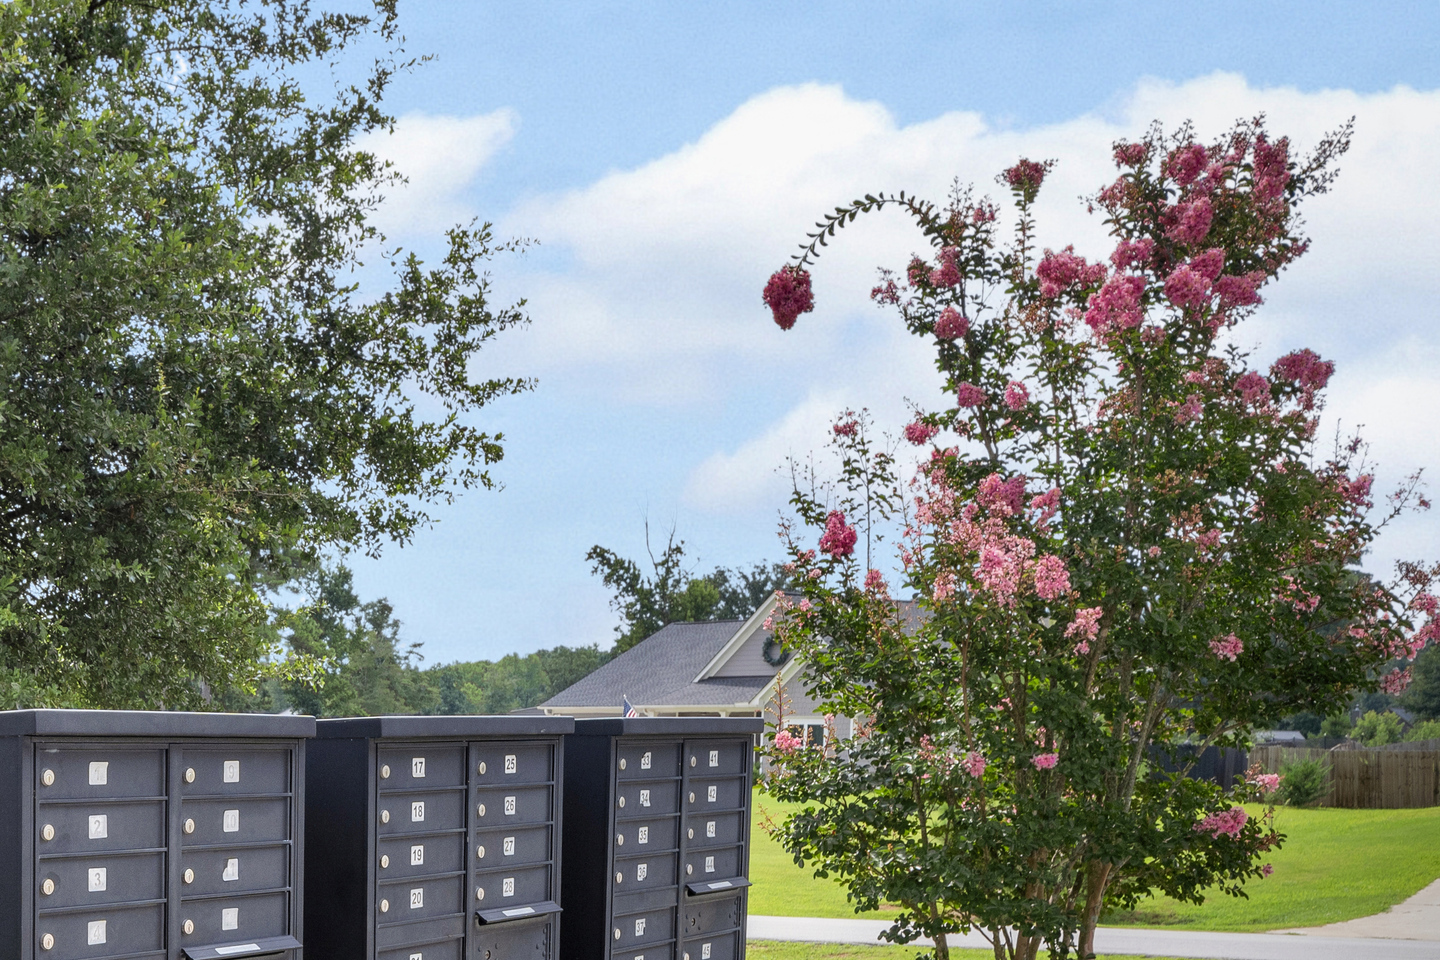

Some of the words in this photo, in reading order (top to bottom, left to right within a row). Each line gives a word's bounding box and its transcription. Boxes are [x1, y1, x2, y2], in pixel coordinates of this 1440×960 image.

[506, 758, 516, 770] 25
[710, 753, 718, 764] 41
[228, 764, 235, 780] 9
[413, 762, 424, 774] 17
[641, 792, 649, 804] 34
[709, 788, 716, 799] 42
[412, 805, 424, 818] 18
[505, 799, 515, 812] 26
[93, 819, 101, 836] 2
[226, 814, 237, 830] 10
[640, 829, 648, 841] 35
[504, 840, 514, 852] 27
[412, 849, 422, 862] 19
[94, 872, 102, 888] 3
[504, 881, 514, 893] 28
[411, 892, 422, 904] 20
[93, 924, 101, 940] 4
[636, 921, 644, 934] 37
